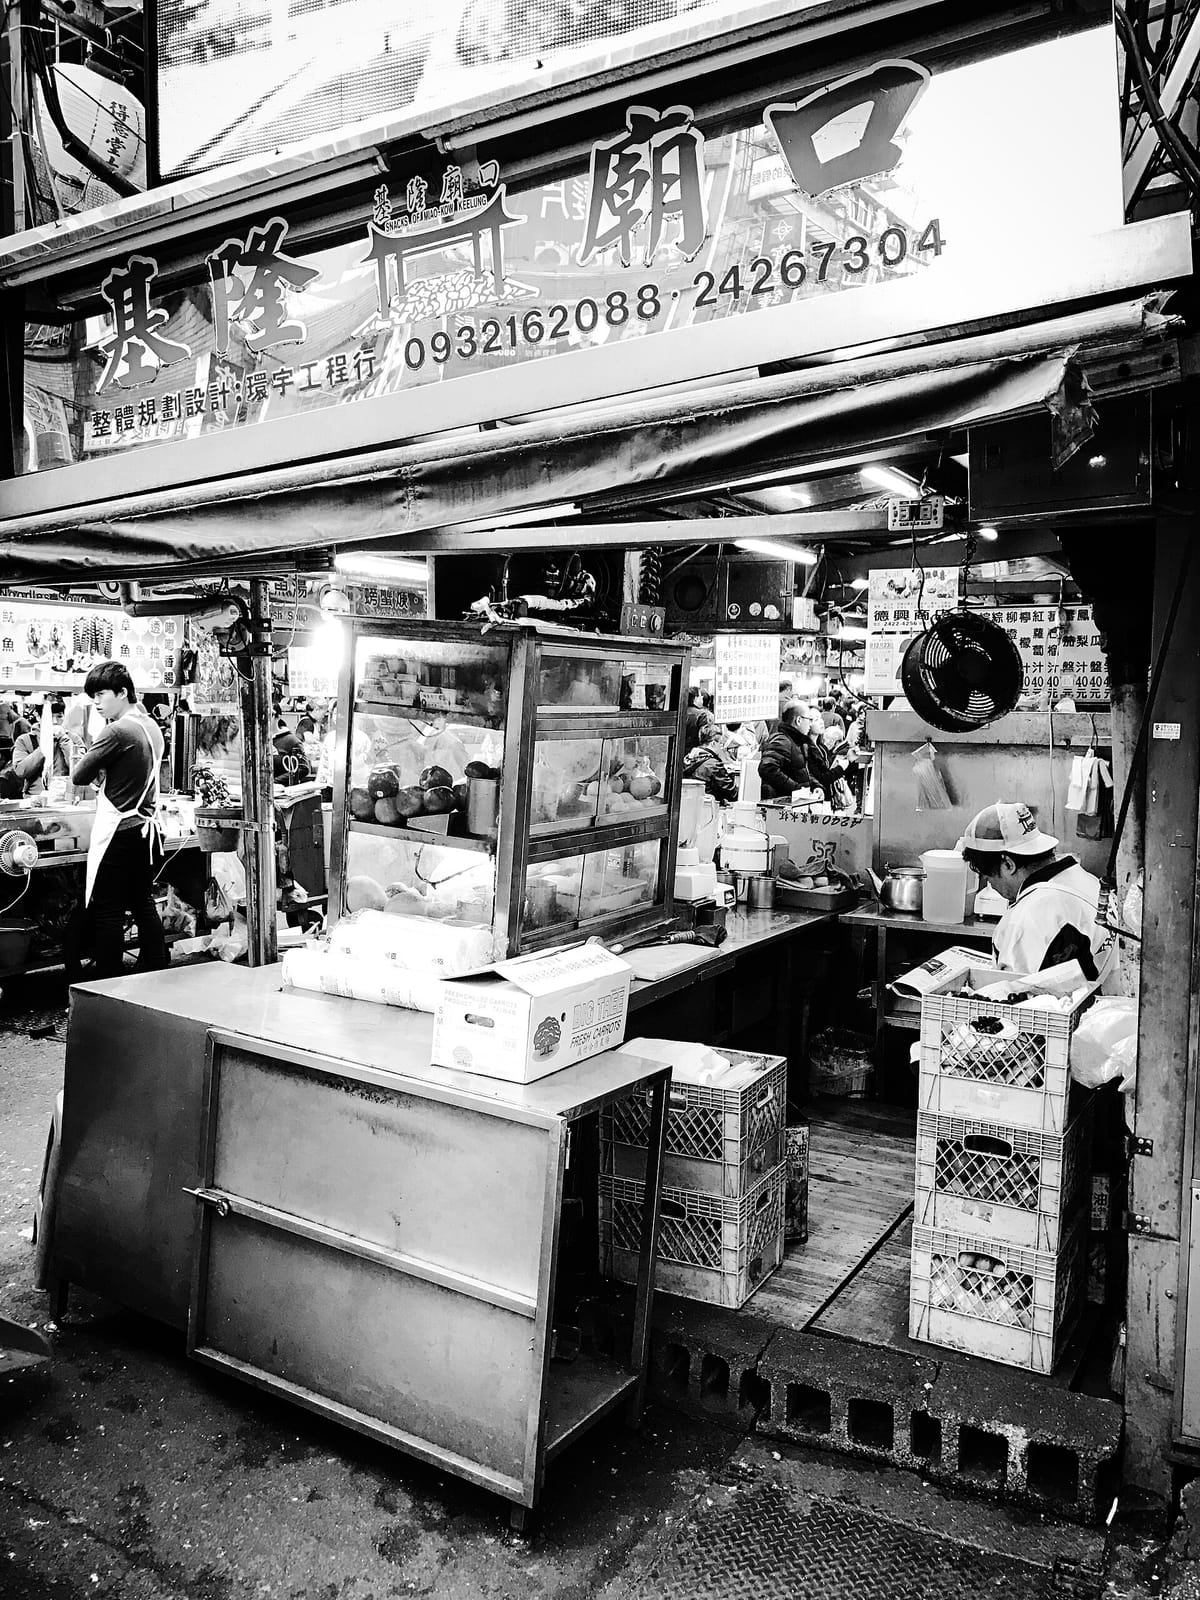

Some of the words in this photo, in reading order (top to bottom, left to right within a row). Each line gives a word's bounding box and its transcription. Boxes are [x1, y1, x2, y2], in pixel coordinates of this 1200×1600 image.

[374, 160, 499, 224] 基隆廟口
[385, 216, 409, 232] SNACKS
[412, 212, 421, 223] OF
[423, 203, 455, 222] MIAO-KOW
[457, 194, 487, 211] KEELUNG
[96, 217, 323, 395] 基隆
[576, 58, 931, 267] 廟口
[692, 218, 947, 309] 24267304
[570, 1031, 592, 1048] FRESH
[593, 1019, 622, 1040] CARROTS
[572, 1000, 595, 1029] BIG
